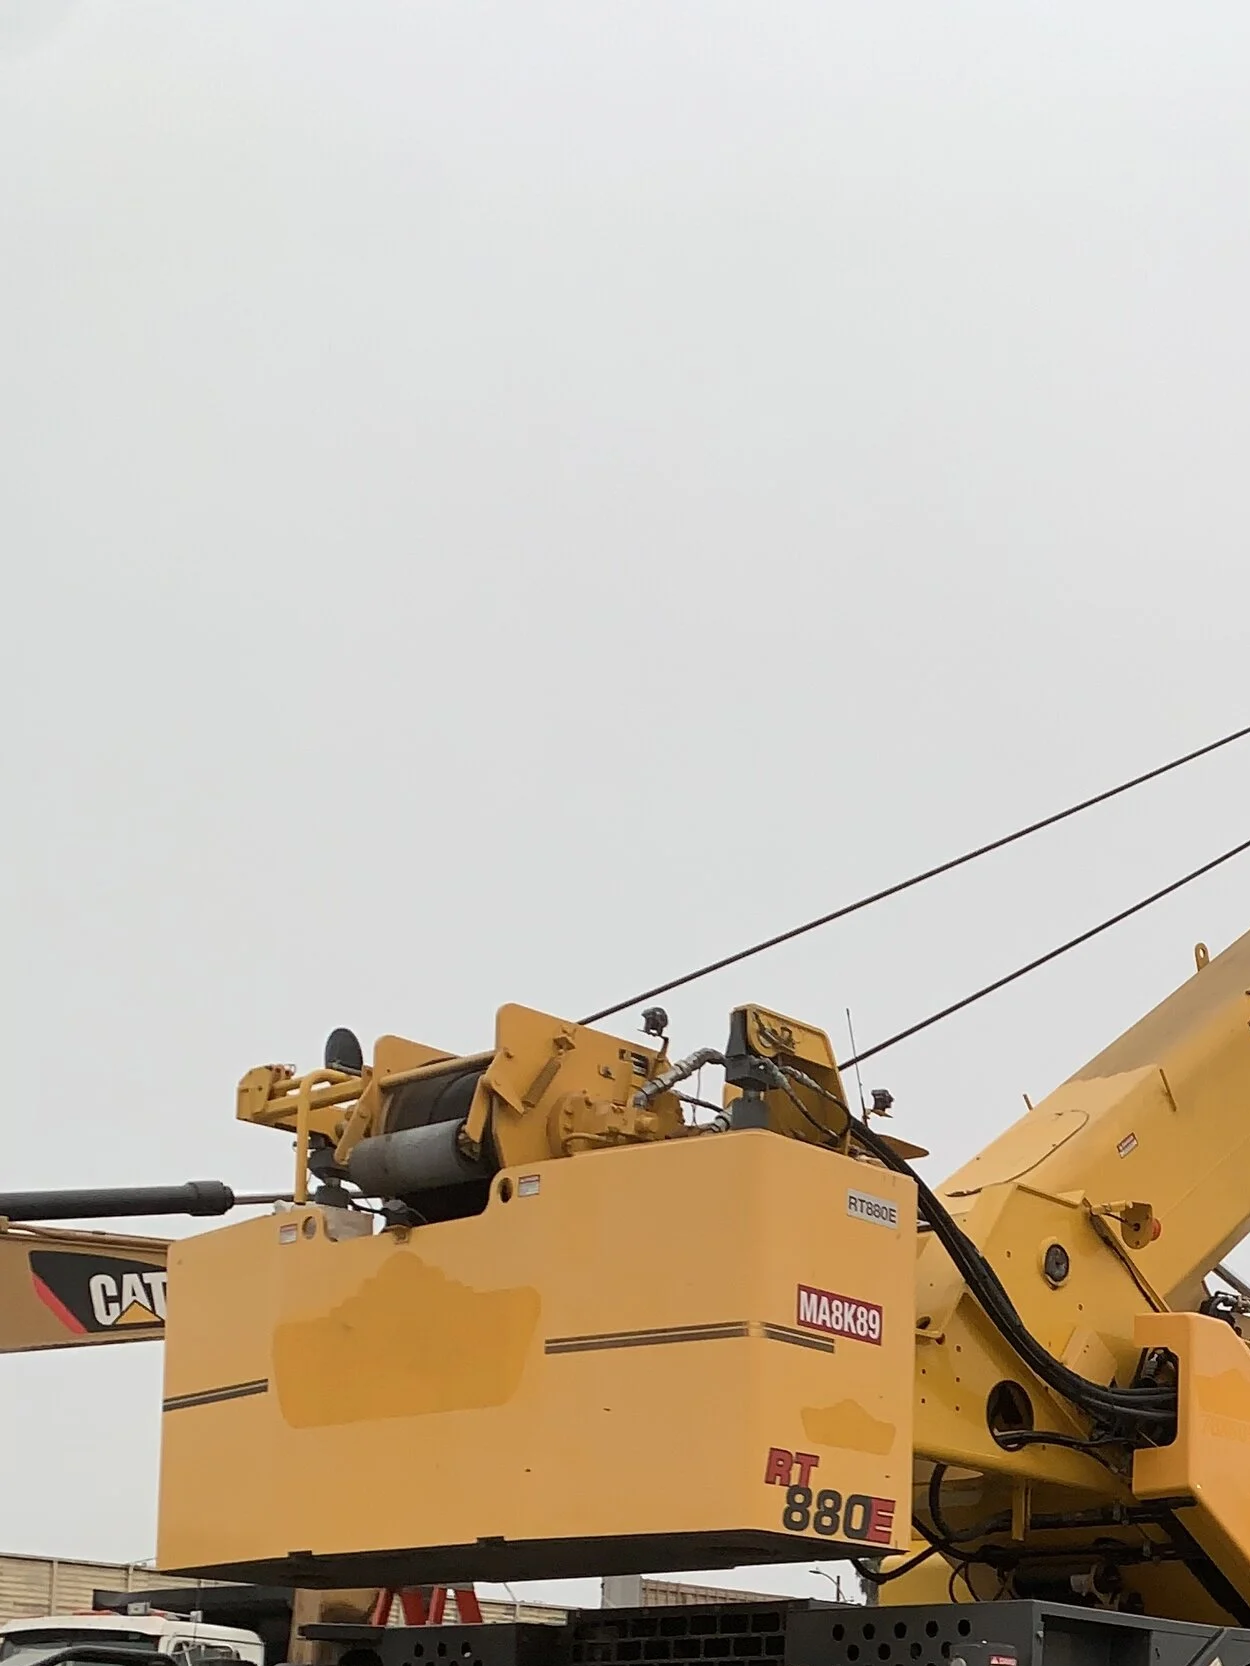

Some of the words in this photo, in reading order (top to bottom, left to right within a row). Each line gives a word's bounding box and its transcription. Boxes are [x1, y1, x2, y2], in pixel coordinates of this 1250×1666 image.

[848, 1195, 897, 1224] RT880E
[89, 1271, 168, 1326] CAT
[799, 1290, 881, 1340] MA8K89
[764, 1447, 820, 1488] RT
